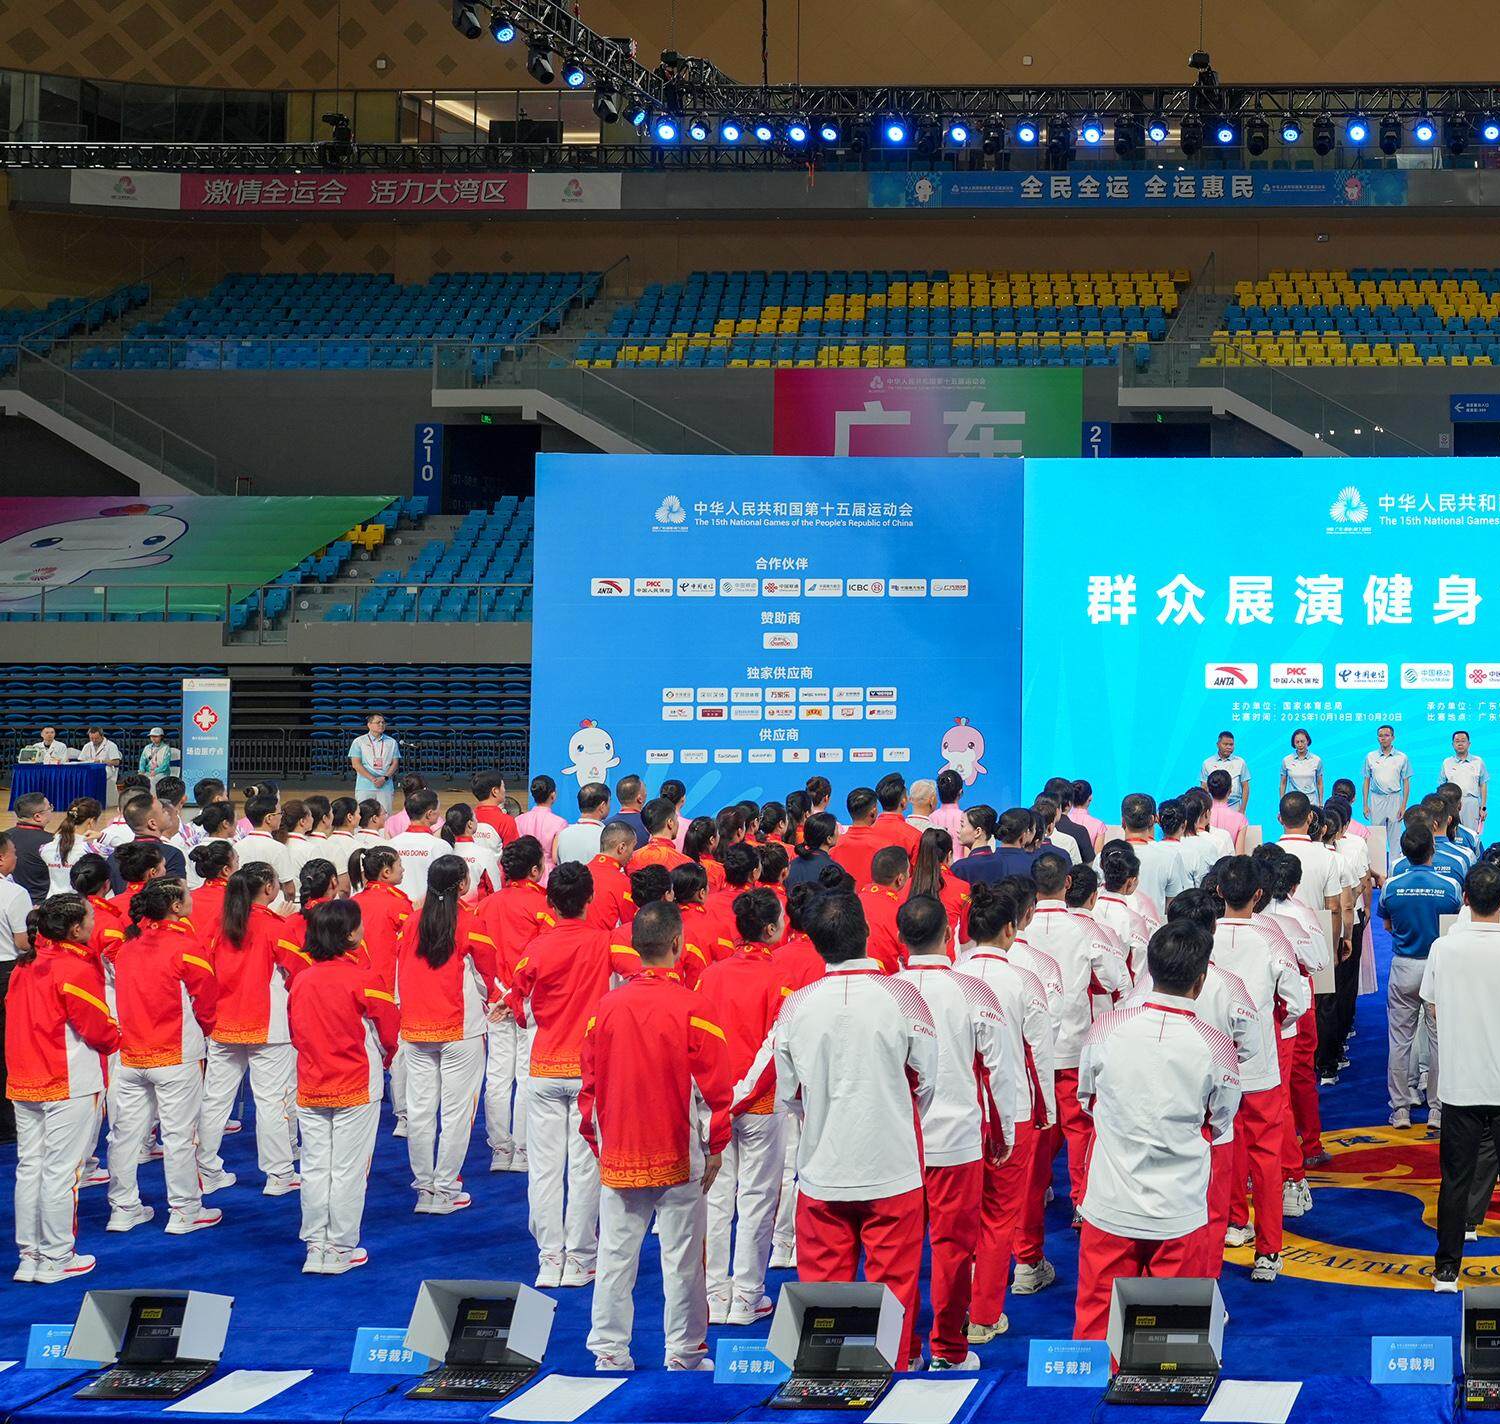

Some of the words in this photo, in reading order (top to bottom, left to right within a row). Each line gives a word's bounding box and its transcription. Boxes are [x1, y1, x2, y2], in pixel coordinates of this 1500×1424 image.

[202, 178, 348, 205] 激情全运会
[367, 178, 508, 204] 活力大湾区
[1019, 174, 1130, 200] 全民全运
[1144, 174, 1255, 199] 全运惠民
[421, 426, 435, 482] 210
[693, 501, 913, 517] 中华人民共和国第十五届运动会
[694, 518, 708, 527] The
[710, 518, 727, 527] 15th
[729, 518, 762, 527] National
[763, 518, 789, 527] Games
[791, 518, 800, 527] of
[801, 518, 813, 527] the
[815, 518, 847, 528] People's
[848, 518, 880, 528] Republic
[882, 518, 890, 527] of
[891, 518, 914, 527] China
[1380, 516, 1397, 525] The
[1400, 516, 1421, 525] 15th
[1424, 516, 1464, 525] National
[1467, 516, 1499, 525] Games
[755, 557, 809, 571] 合作伙伴
[849, 584, 869, 592] ICBC
[760, 611, 801, 625] 赞助商
[746, 666, 813, 680] 独家供应商
[1286, 667, 1307, 676] PICC
[1214, 676, 1235, 686] ANTA
[759, 728, 800, 742] 供应商
[1280, 1244, 1416, 1276] HEALTH
[42, 1344, 67, 1358] 2号
[368, 1348, 414, 1362] 3号裁判
[728, 1359, 775, 1374] 4号裁判
[1044, 1360, 1092, 1375] 5号裁判
[1388, 1357, 1435, 1371] 6号裁判
